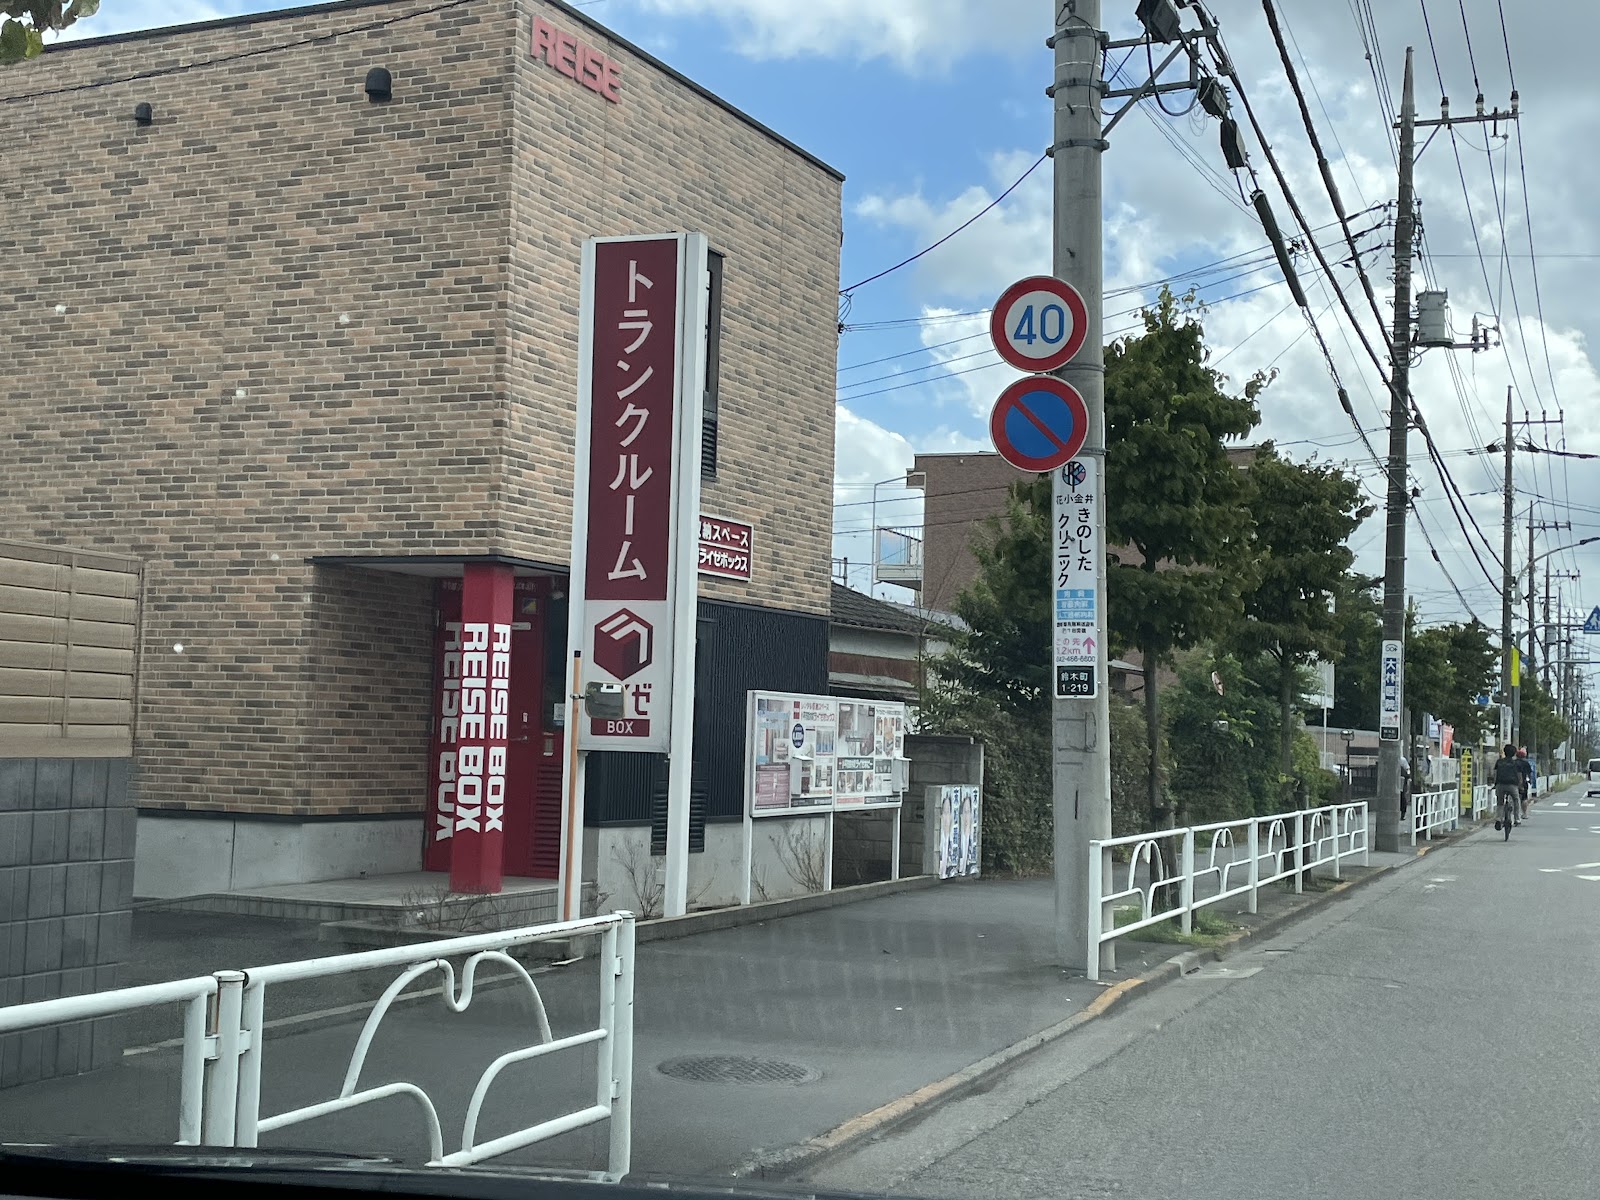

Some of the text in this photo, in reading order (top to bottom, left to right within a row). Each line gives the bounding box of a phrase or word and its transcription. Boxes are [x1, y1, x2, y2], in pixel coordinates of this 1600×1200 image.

[531, 15, 622, 104] REISE
[1013, 304, 1065, 345] 40
[608, 261, 655, 581] トランクルーム
[1058, 513, 1071, 588] クリニック
[1076, 507, 1092, 571] きのした
[1061, 672, 1088, 681] 鈴木町
[1061, 683, 1089, 692] 1-219
[455, 622, 489, 833] REISE BOX
[485, 623, 511, 833] REISE BOX
[607, 720, 634, 734] BOX
